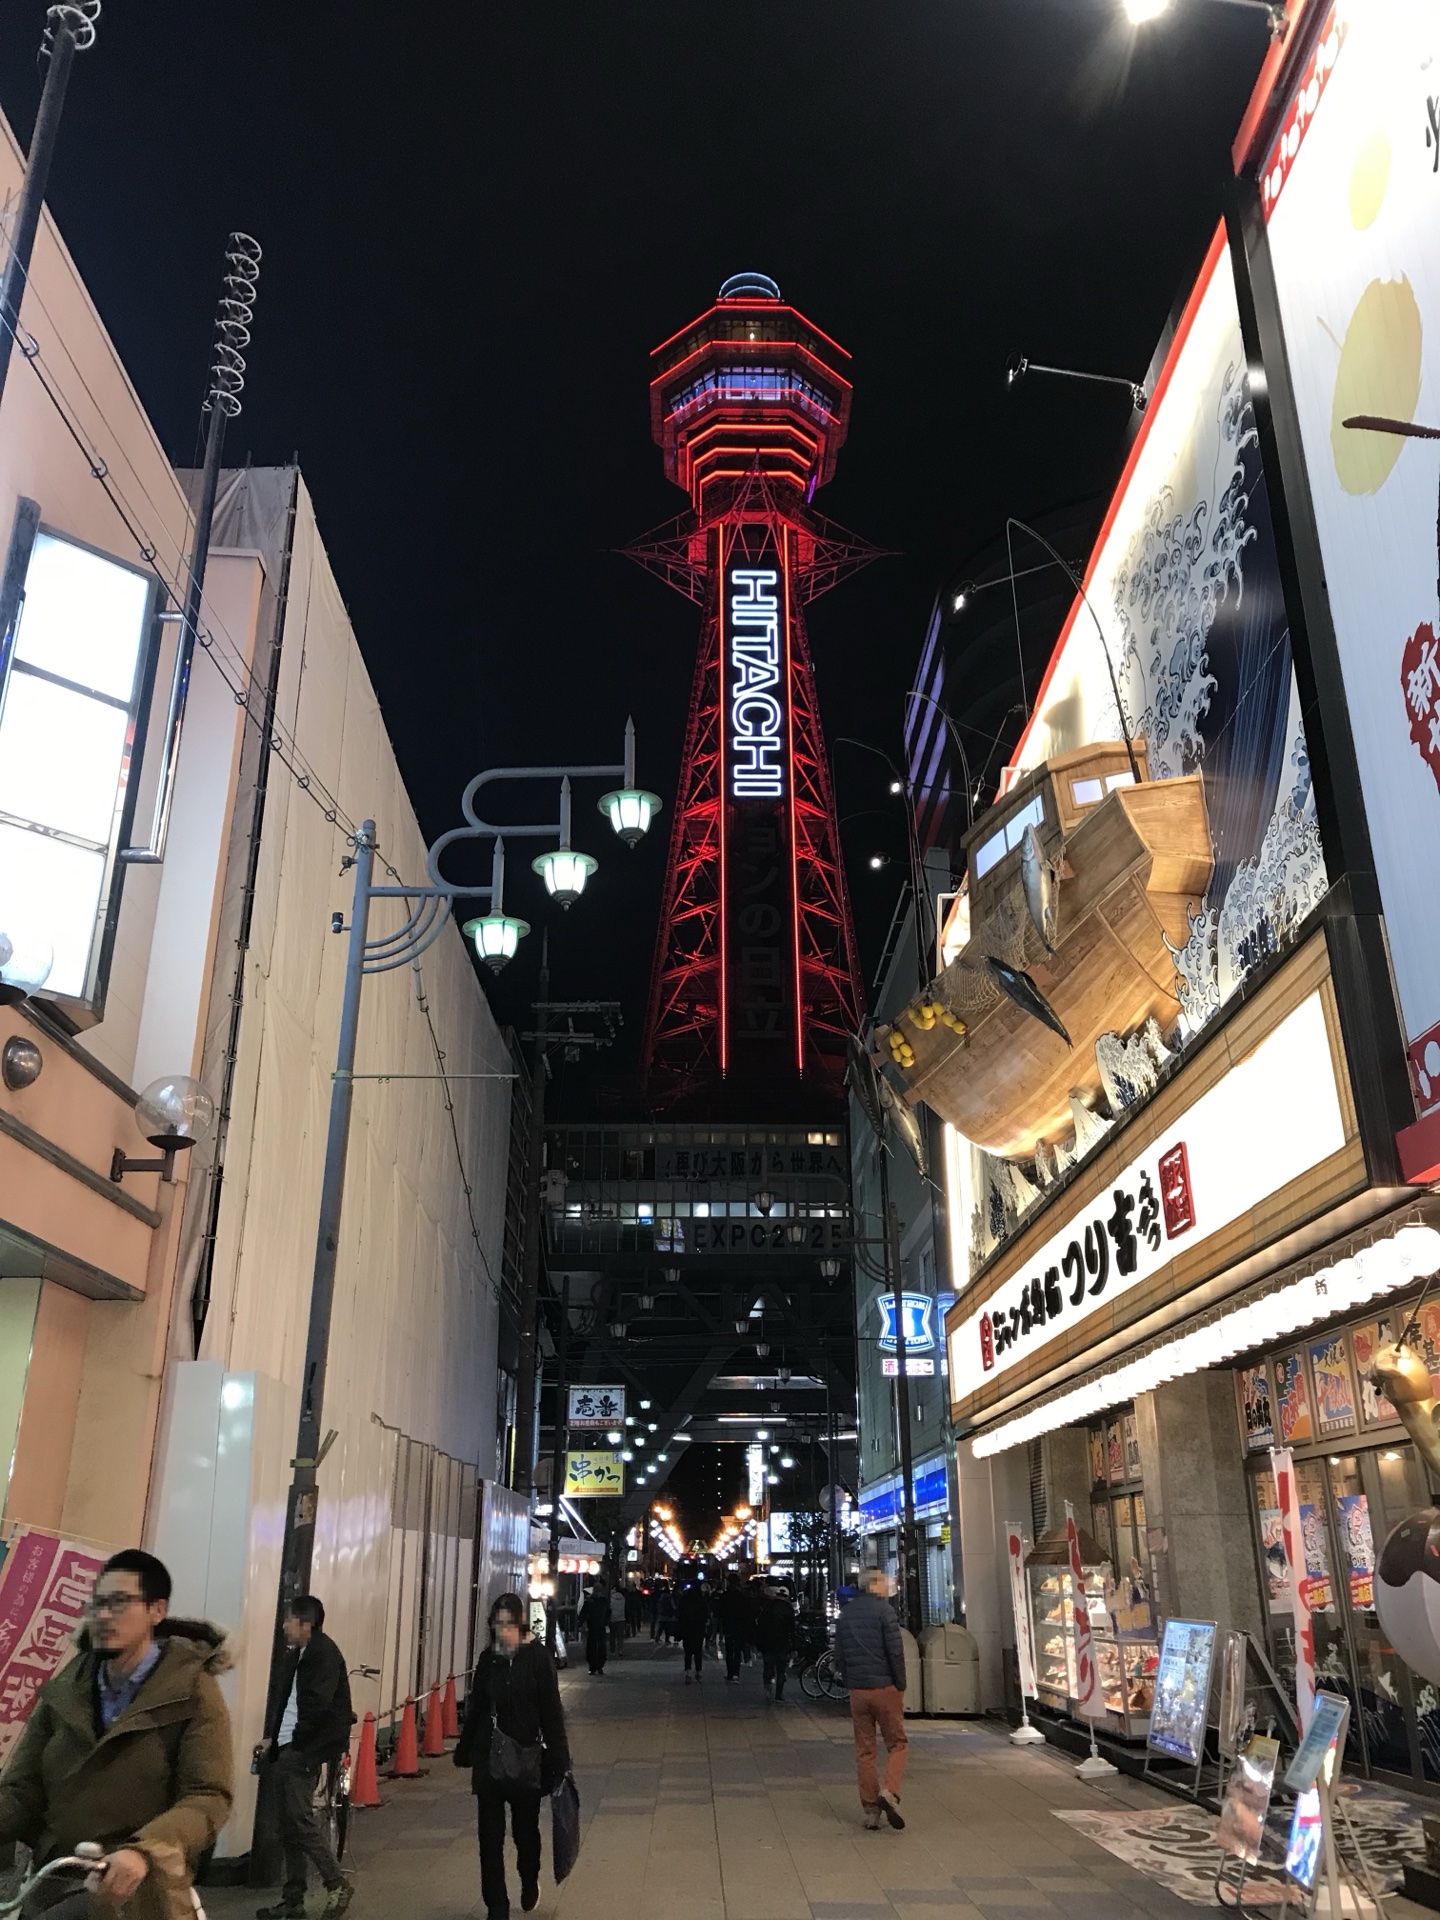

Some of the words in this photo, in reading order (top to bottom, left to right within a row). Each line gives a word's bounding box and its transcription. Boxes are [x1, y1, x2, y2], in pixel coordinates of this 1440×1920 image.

[731, 569, 782, 797] HITACHI
[693, 1223, 842, 1249] EXPO225
[568, 1453, 621, 1486] 串かつ
